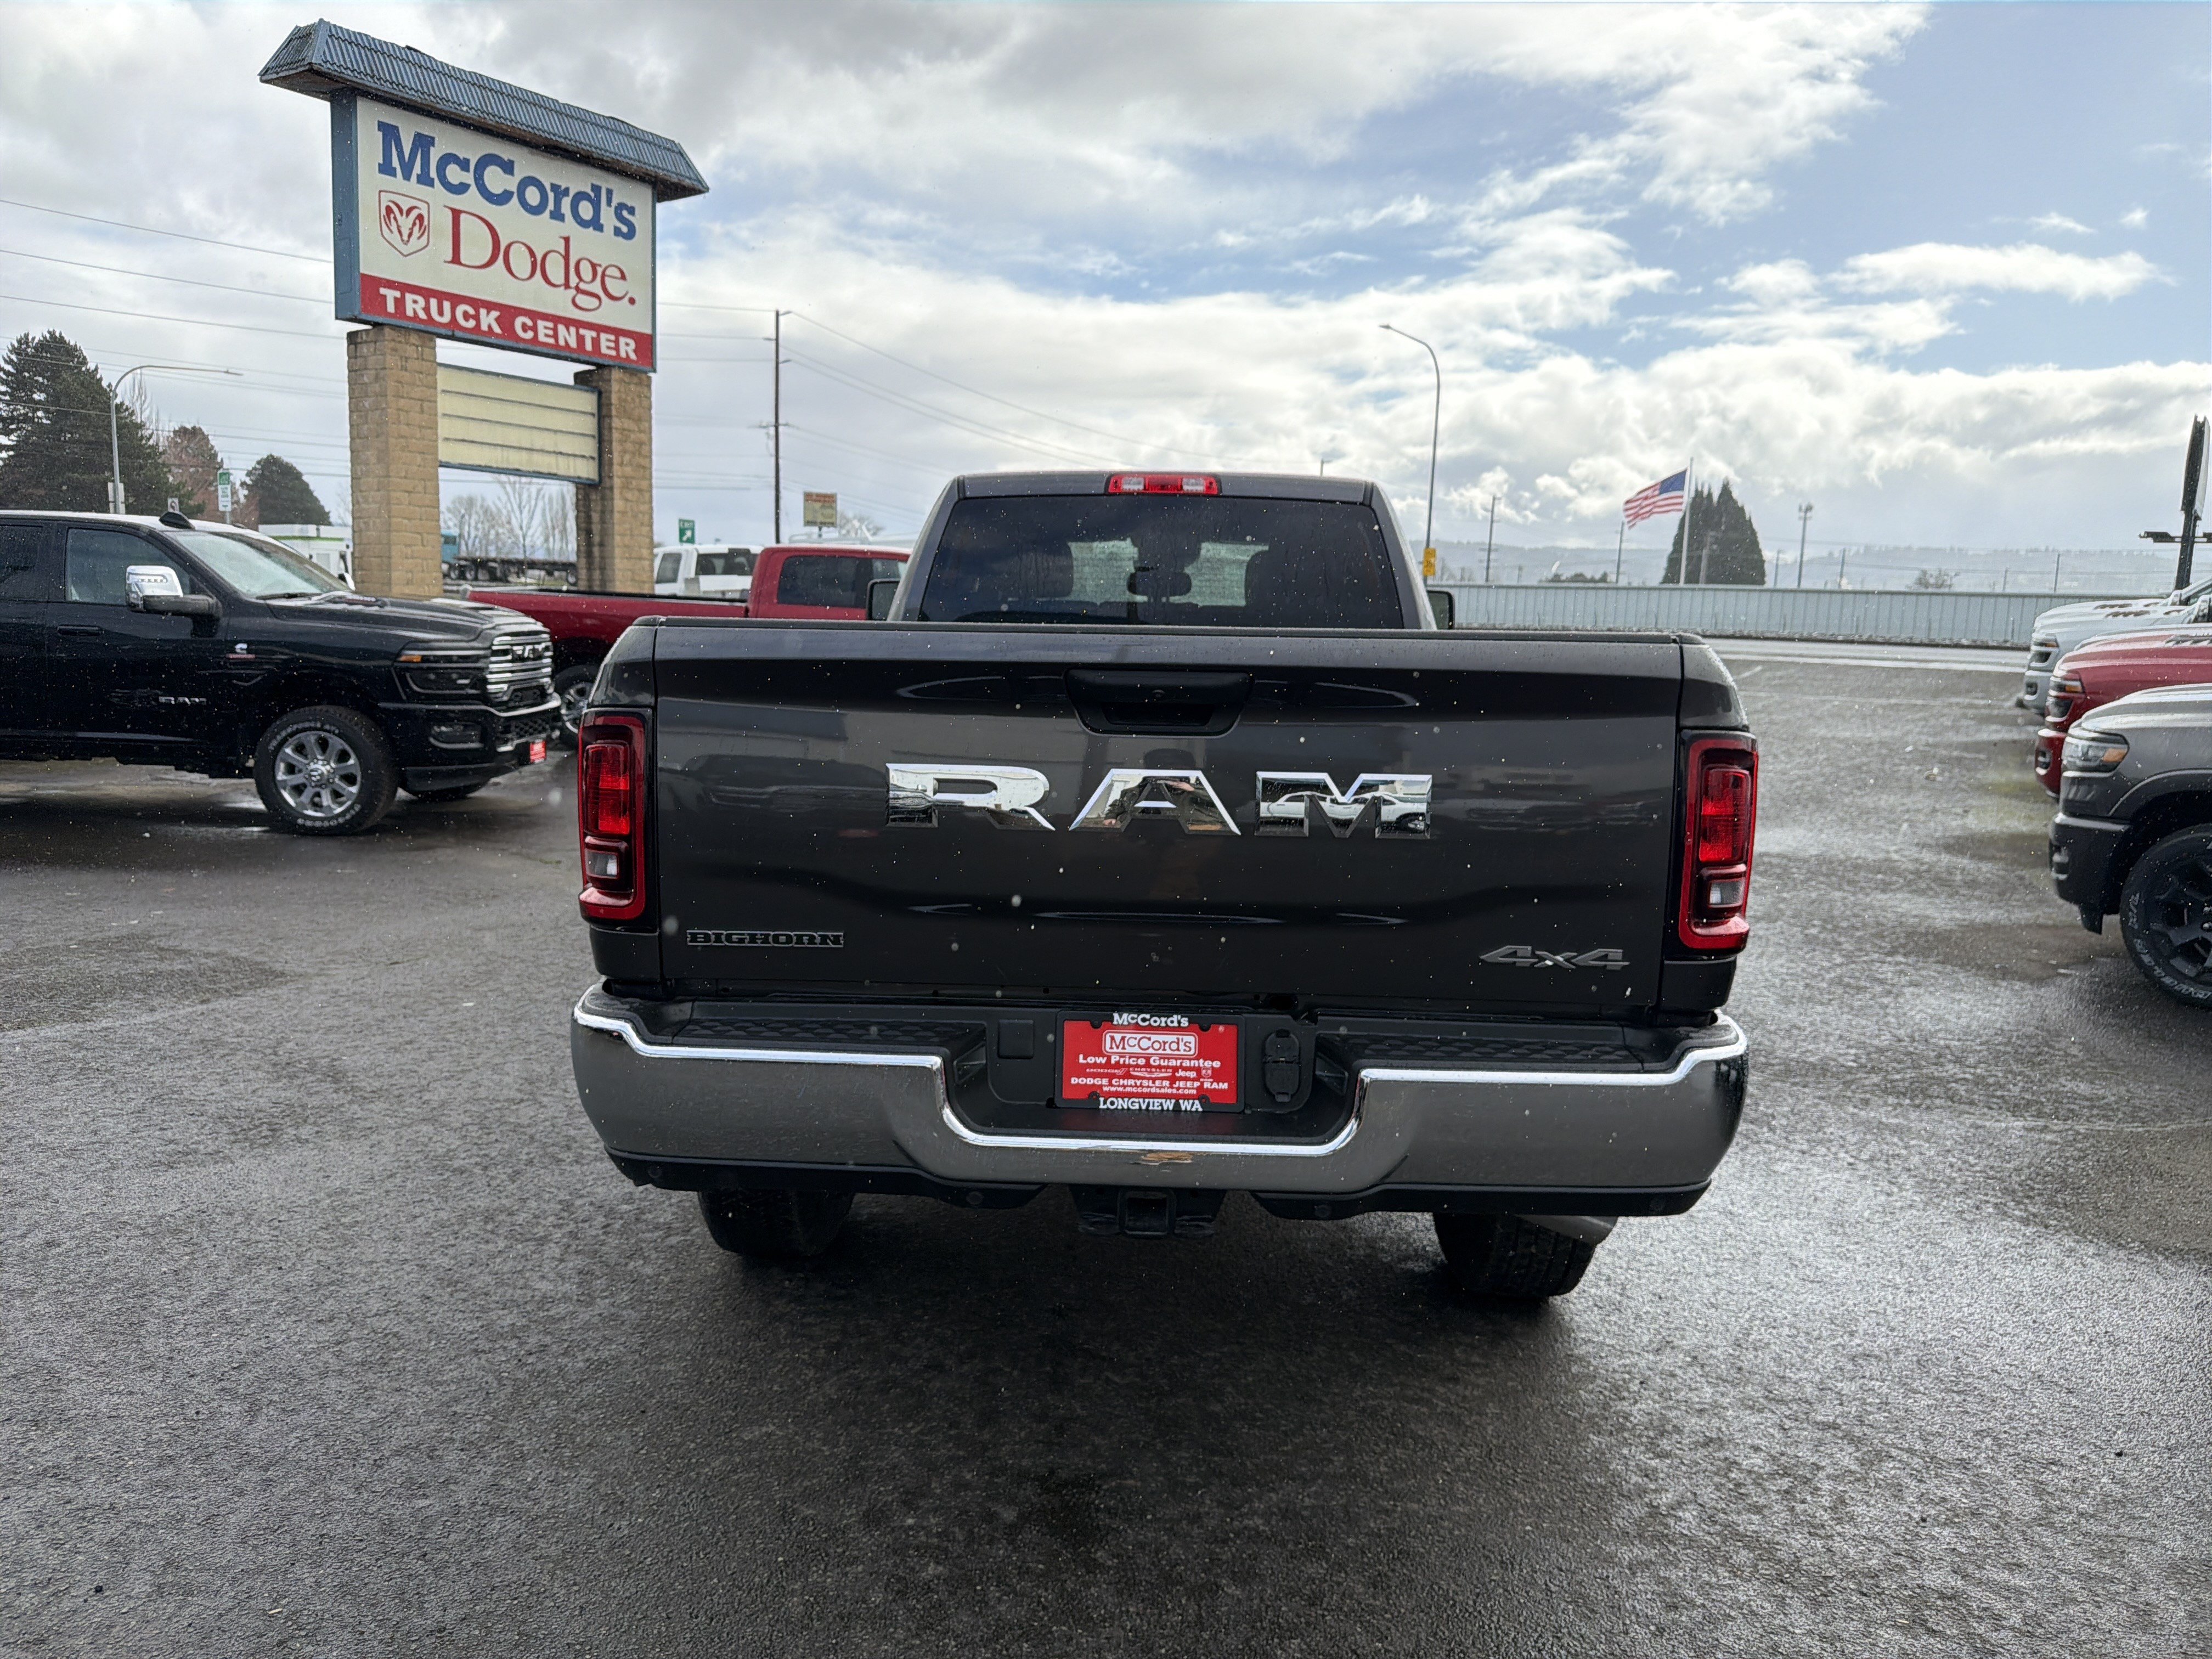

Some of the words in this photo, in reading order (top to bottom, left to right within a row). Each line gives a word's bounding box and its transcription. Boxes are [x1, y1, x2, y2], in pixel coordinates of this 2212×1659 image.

[377, 120, 636, 240] McCord's
[379, 288, 503, 334] TRUCK
[515, 316, 636, 360] CENTER
[886, 763, 1432, 838] RAM
[686, 930, 844, 947] BIGHORN
[1113, 1013, 1189, 1027] McCord's
[1109, 1035, 1192, 1052] McCord's
[1079, 1054, 1107, 1064] Low
[1111, 1056, 1146, 1065] Price
[1150, 1056, 1221, 1068] Guarantee
[1175, 1069, 1197, 1078] Jeep
[1071, 1077, 1109, 1085] DODGE
[1111, 1078, 1170, 1087] CHRYSLER
[1102, 1085, 1197, 1094] www.mccordsales.com
[1099, 1097, 1176, 1111] LONGVIEW
[1180, 1099, 1203, 1111] WA
